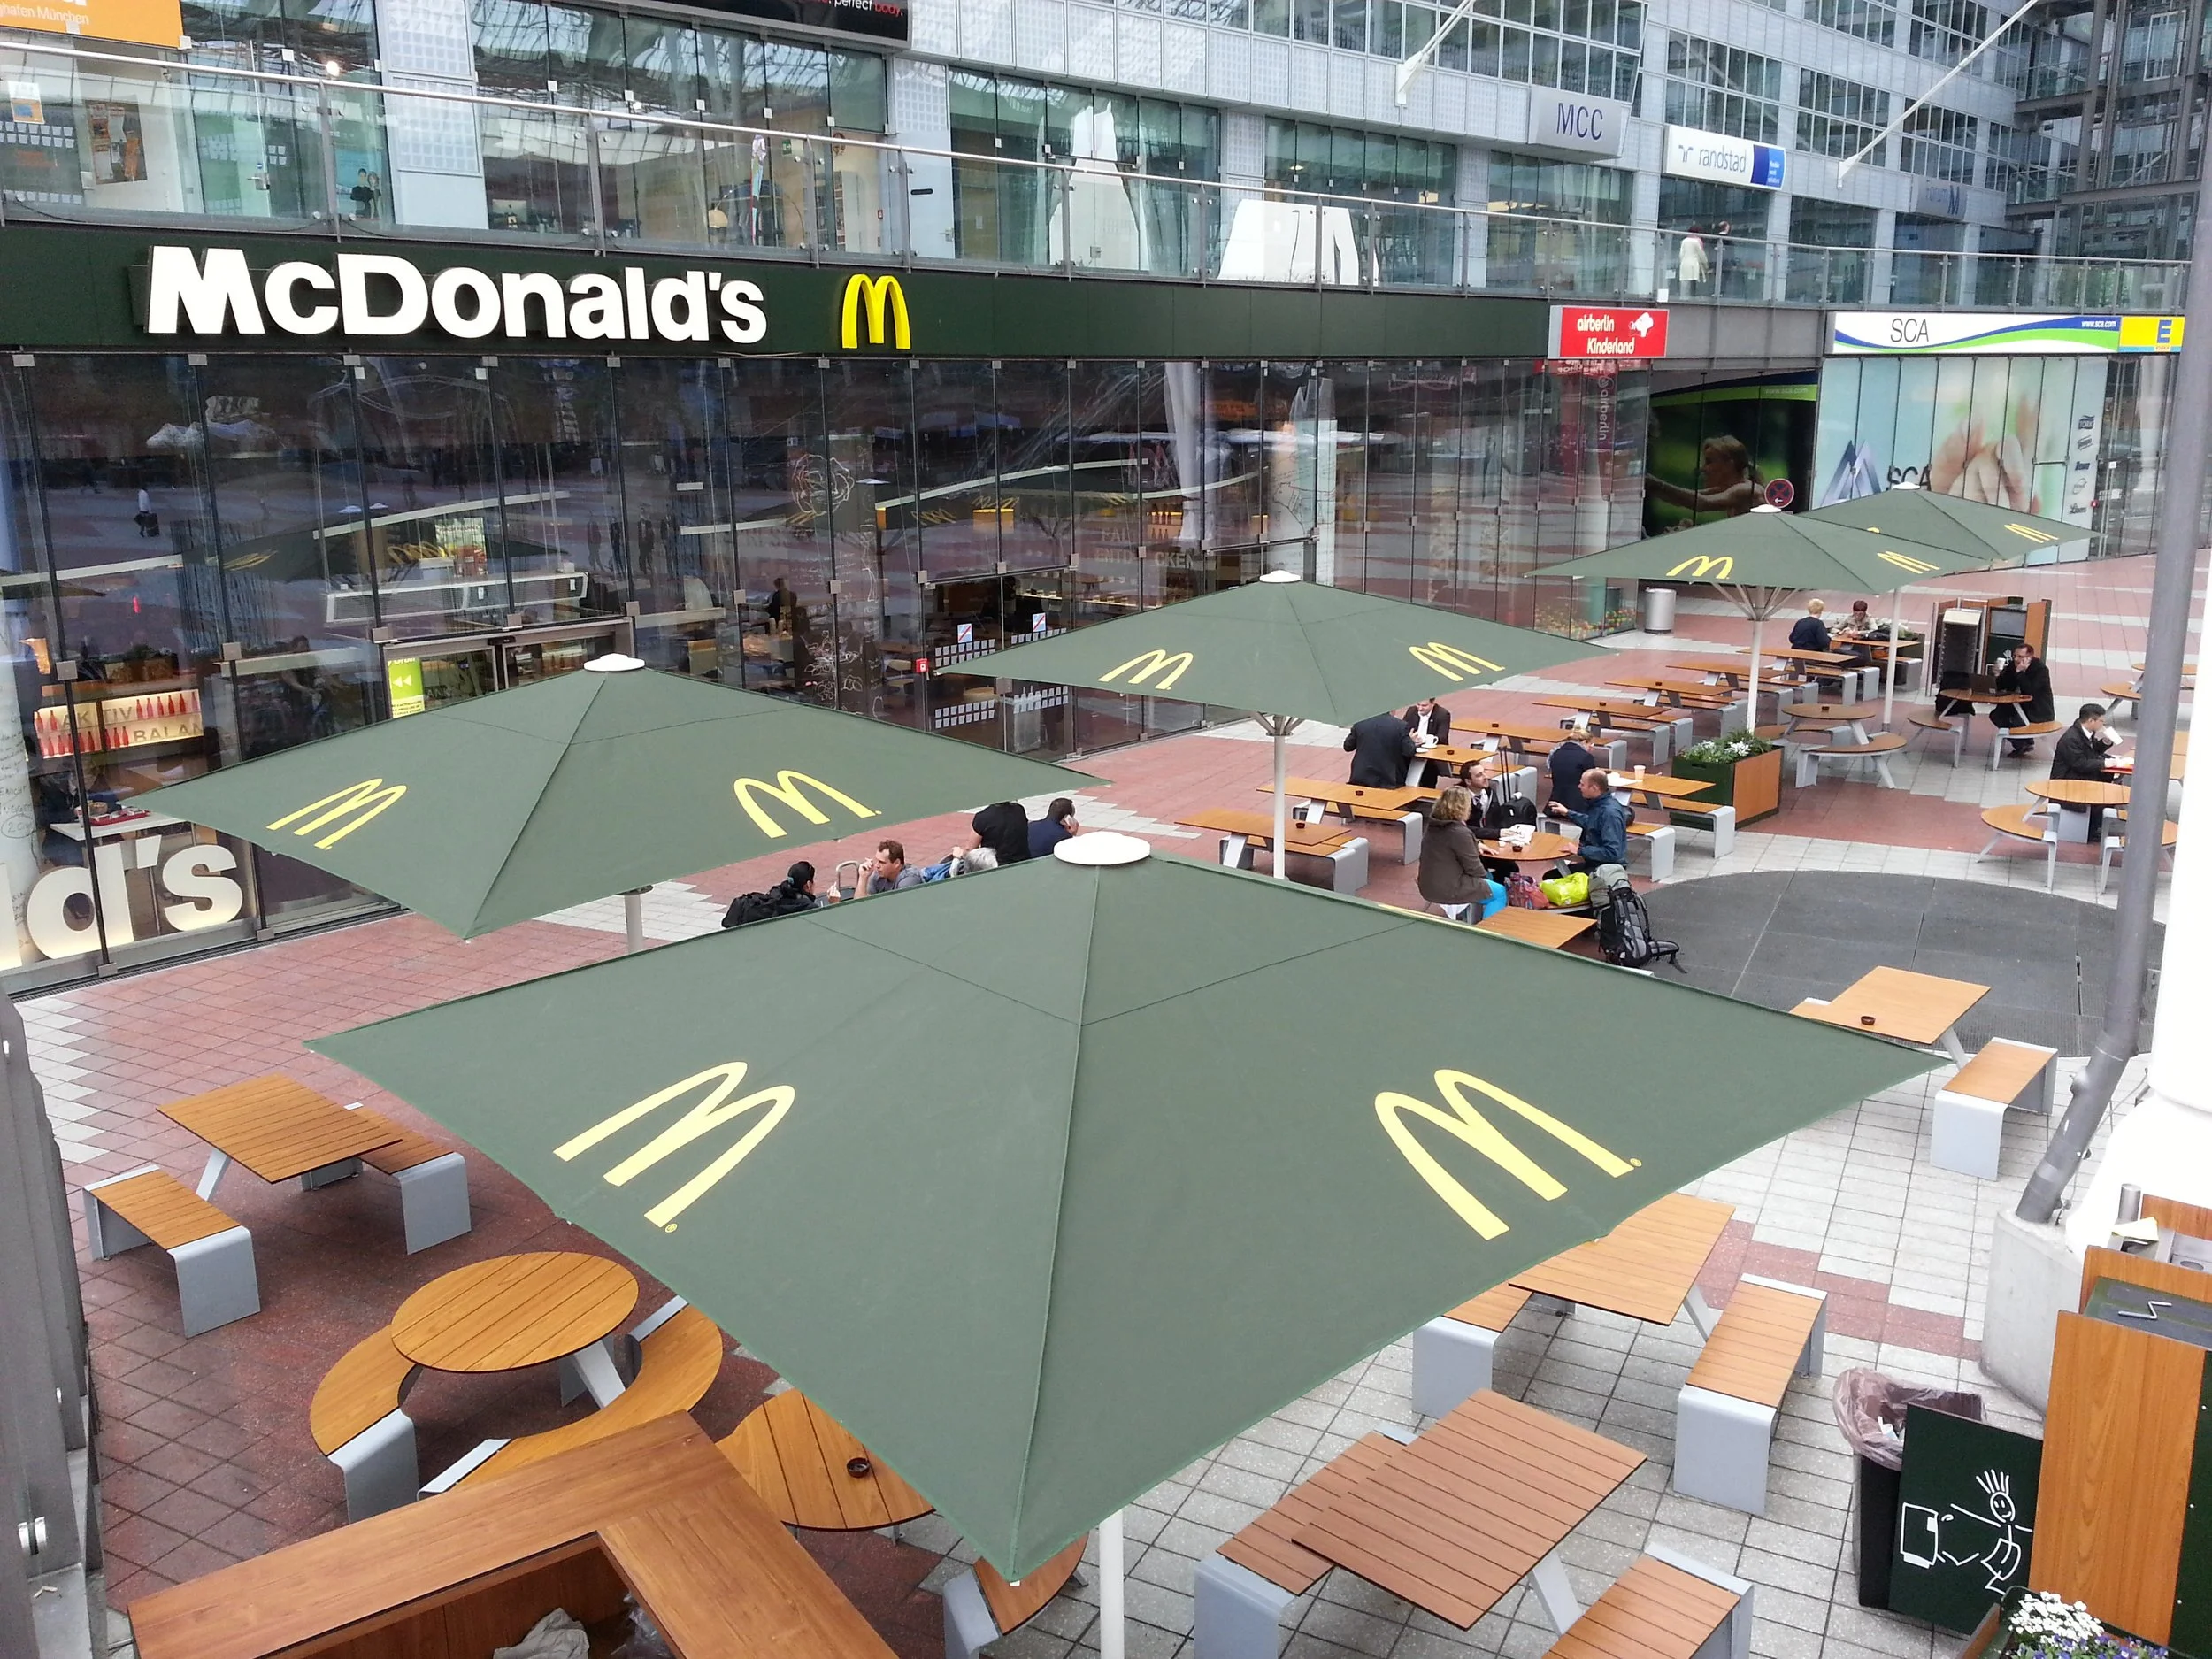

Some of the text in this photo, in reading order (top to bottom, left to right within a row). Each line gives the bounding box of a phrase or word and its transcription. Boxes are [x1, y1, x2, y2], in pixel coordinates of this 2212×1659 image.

[1556, 102, 1603, 141] MCC
[1698, 144, 1747, 173] randstad
[1947, 184, 1960, 215] M
[147, 246, 767, 344] McDonald's
[1577, 314, 1615, 332] airberlin
[1890, 318, 1929, 342] SCA
[1586, 337, 1635, 354] Kinderland
[1598, 388, 1611, 441] airberlin
[1886, 464, 1932, 492] SCA
